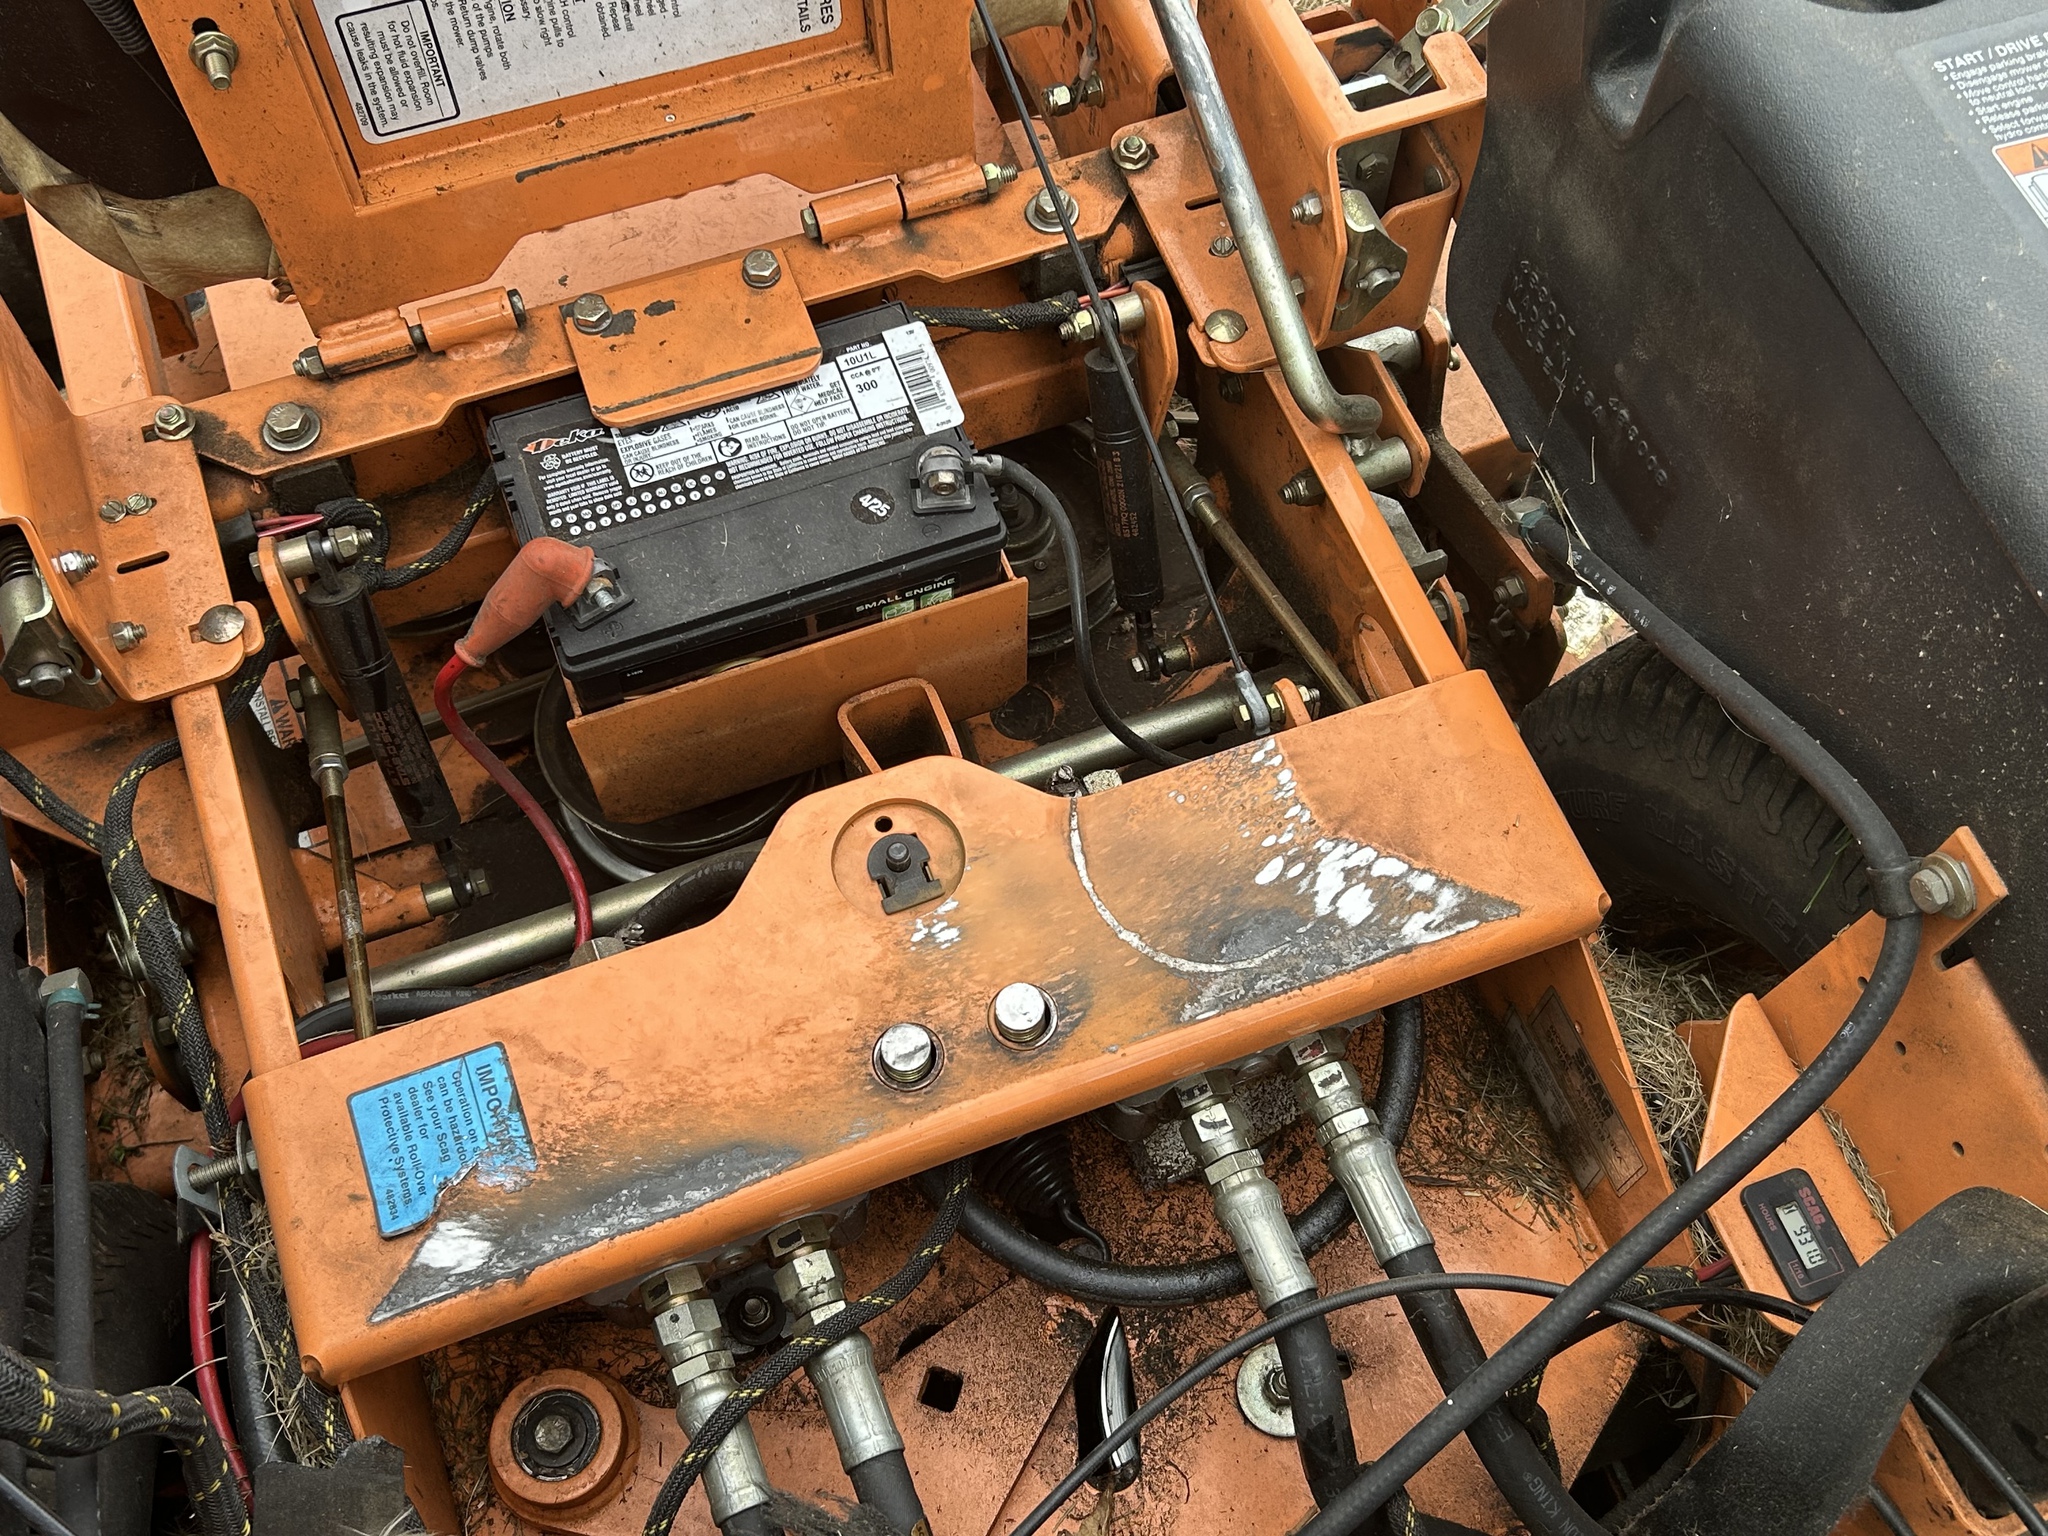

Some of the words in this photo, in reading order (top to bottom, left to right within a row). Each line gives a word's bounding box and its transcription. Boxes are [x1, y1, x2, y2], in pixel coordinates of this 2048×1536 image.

[444, 1, 455, 16] the
[471, 2, 481, 13] of
[534, 5, 546, 25] slow
[608, 1, 621, 31] Repeat
[386, 19, 398, 33] for
[400, 19, 412, 33] Do
[475, 12, 486, 28] the
[561, 8, 575, 38] control
[595, 1, 609, 39] obtained.
[623, 13, 633, 31] until
[345, 20, 361, 47] cause
[376, 29, 390, 52] must
[391, 33, 403, 49] hot
[404, 33, 417, 49] not
[448, 16, 464, 48] mower.
[538, 26, 552, 46] right
[549, 16, 562, 37] pulls
[556, 38, 565, 47] to
[477, 28, 494, 58] pumps
[491, 24, 505, 50] rotate
[499, 50, 512, 70] both
[1933, 50, 1984, 72] START
[1994, 34, 2042, 56] DRIVE
[356, 48, 370, 70] leaks
[384, 52, 395, 65] be
[396, 49, 410, 69] fluid
[409, 49, 427, 80] overfill.
[419, 29, 446, 88] IMPORTANT
[465, 28, 480, 53] dump
[474, 54, 487, 81] valves
[358, 21, 380, 59] resulting
[372, 60, 394, 102] expansion
[386, 103, 399, 121] may
[364, 71, 373, 80] in
[1950, 65, 1987, 81] Engage
[1989, 56, 2024, 72] parking
[1957, 70, 2007, 90] Disengage
[2009, 62, 2040, 76] mower
[367, 81, 378, 95] the
[388, 65, 406, 97] allowed
[401, 69, 423, 112] expansion
[1963, 86, 1990, 98] Move
[1992, 76, 2025, 91] control
[399, 98, 408, 108] or
[420, 80, 435, 106] Room
[1969, 98, 1979, 106] to
[1982, 89, 2013, 102] neutral
[2016, 83, 2035, 93] lock
[354, 101, 368, 125] 482709
[371, 96, 390, 127] system.
[1975, 102, 1999, 115] Start
[2001, 95, 2033, 110] engine
[1982, 108, 2020, 124] Release
[1989, 119, 2019, 133] Select
[1995, 128, 2022, 143] hydro
[843, 350, 876, 366] 10U1L
[846, 344, 860, 352] PART
[850, 371, 863, 379] CCA
[801, 381, 822, 391] WATER.
[817, 386, 843, 398] MEDICAL
[855, 379, 878, 393] 300
[813, 398, 828, 406] HELP
[829, 393, 845, 402] FAST.
[740, 412, 756, 420] CAUSE
[757, 403, 784, 415] BLINDNESS
[740, 418, 757, 426] SEVERE
[812, 415, 826, 423] OPEN
[802, 425, 815, 433] NOT
[523, 428, 605, 456] Deka
[620, 440, 651, 453] EXPLOSIVE
[652, 433, 671, 443] GASES
[634, 447, 650, 456] CAUSE
[651, 439, 679, 451] BLINDNESS
[747, 433, 786, 449] INSTRUCTIONS
[561, 449, 582, 459] BATTERY
[655, 461, 669, 470] KEEP
[657, 466, 676, 475] REACH
[685, 455, 712, 467] CHILDREN
[859, 492, 890, 519] 4/25
[855, 594, 903, 613] SMALL
[905, 577, 956, 598] ENGINE
[422, 1080, 437, 1103] See
[436, 1075, 450, 1097] can
[443, 1098, 456, 1113] be
[407, 1085, 425, 1121] dealer
[417, 1122, 430, 1140] for
[426, 1103, 443, 1131] your
[450, 1070, 474, 1127] Operation
[466, 1127, 479, 1143] on
[378, 1096, 401, 1154] Protective
[393, 1155, 415, 1207] Systems.
[392, 1090, 415, 1142] available
[406, 1143, 430, 1196] Roll-Over
[434, 1132, 452, 1163] Scag
[1797, 1185, 1826, 1227] SCAG
[1757, 1202, 1777, 1232] HOURS
[1791, 1262, 1804, 1279] 1/10
